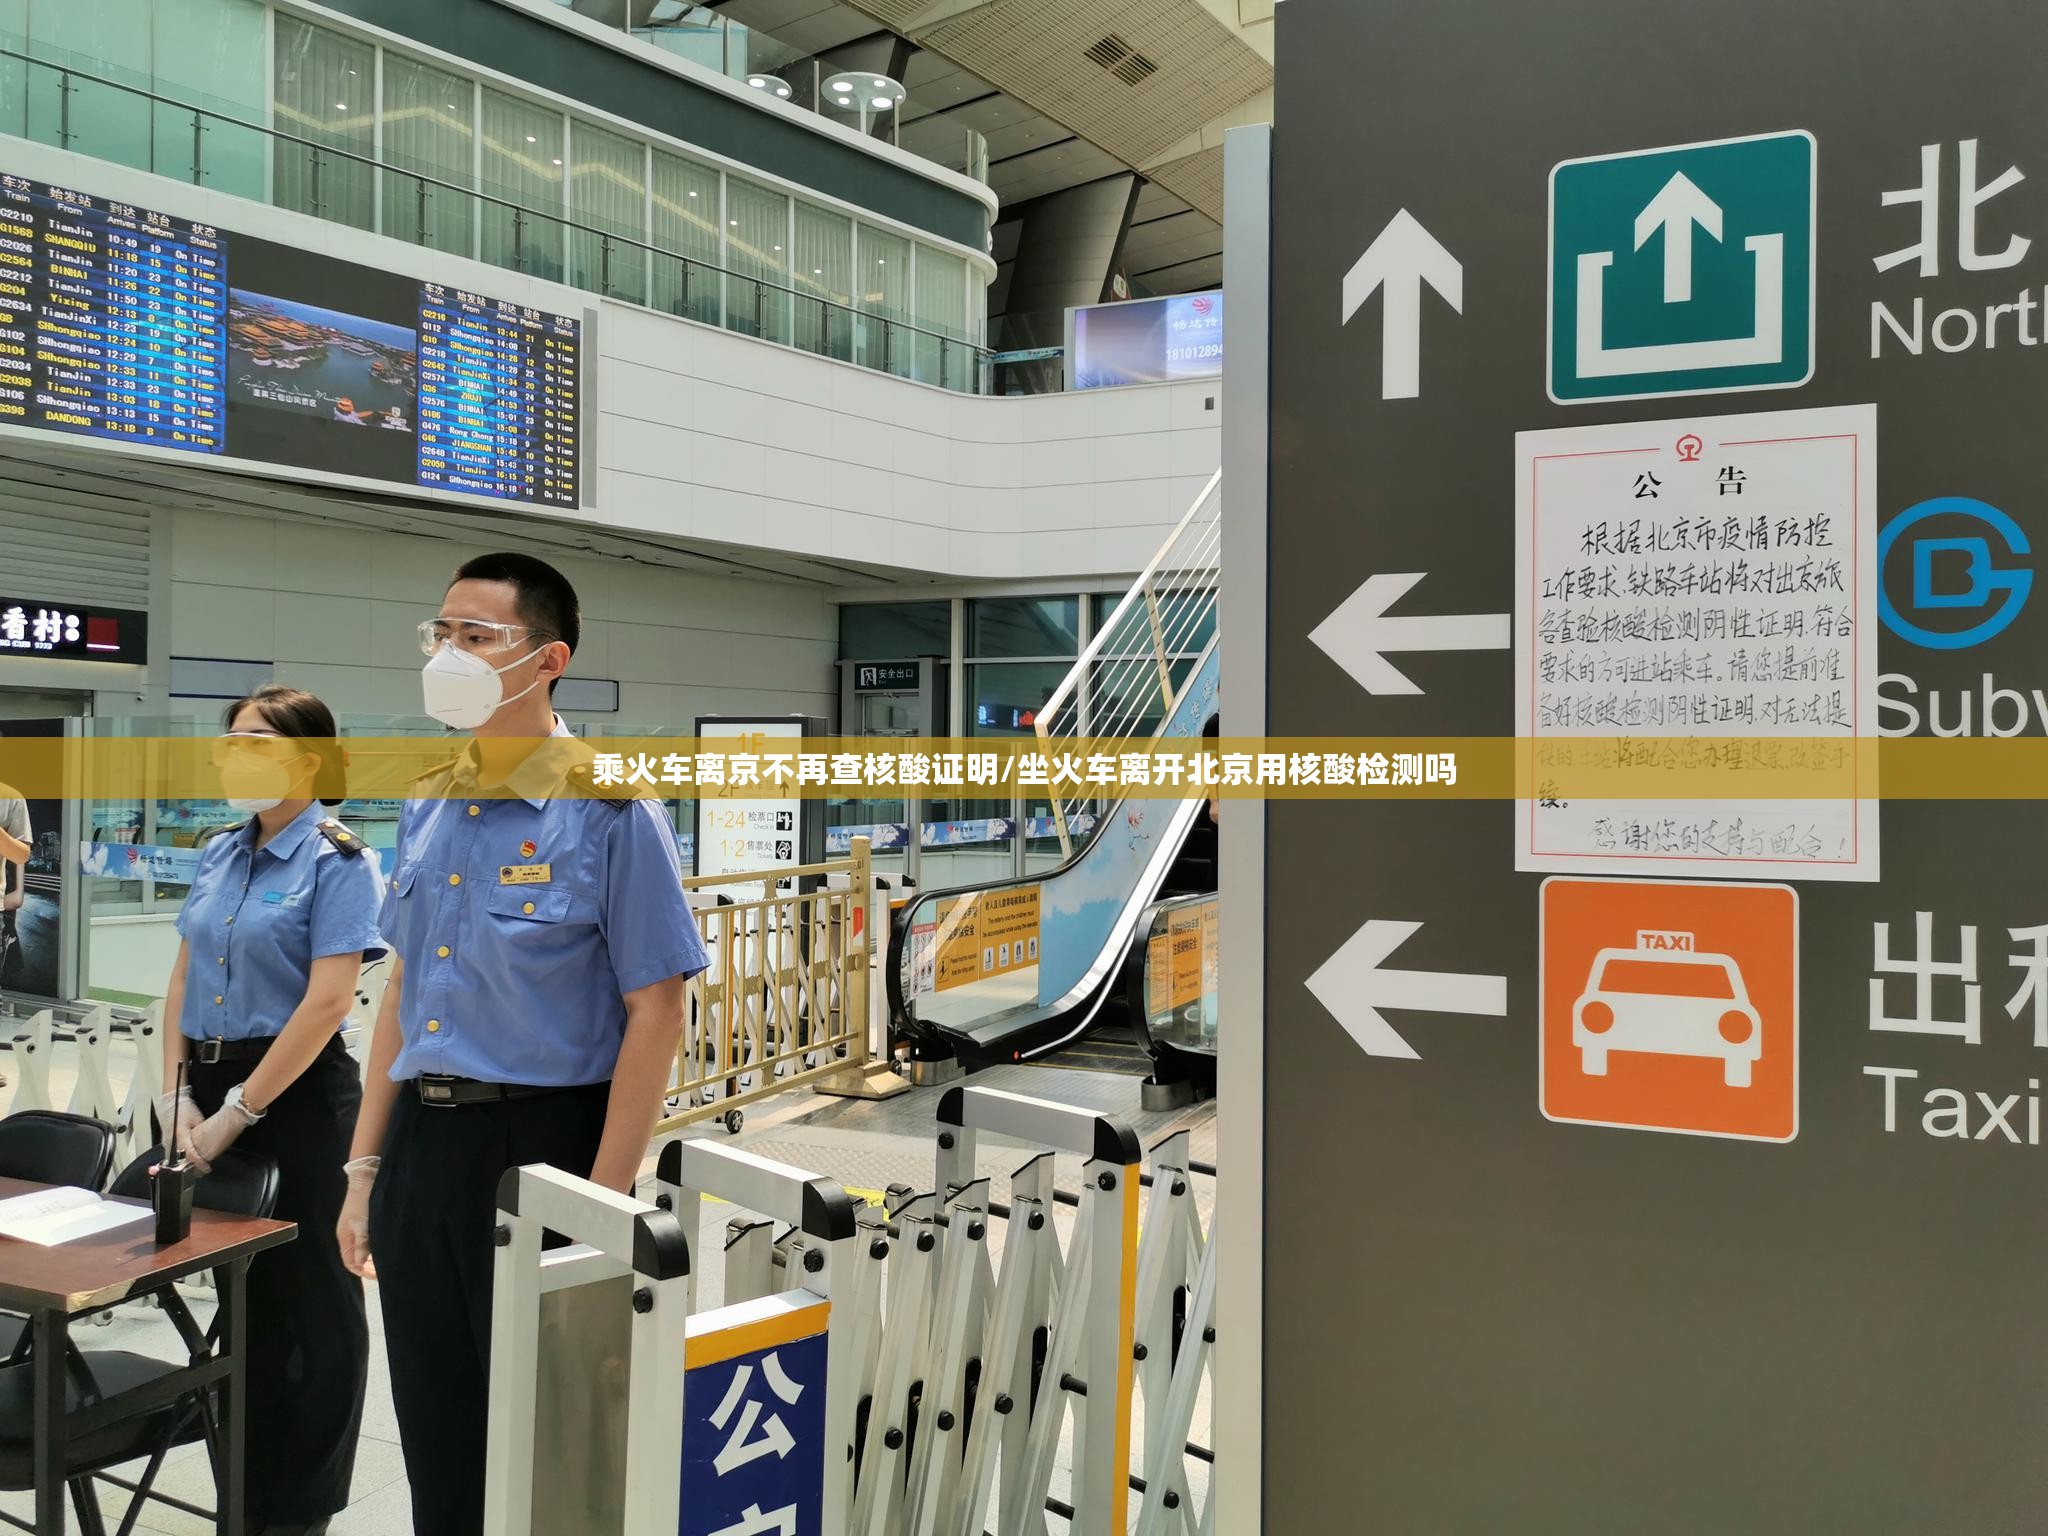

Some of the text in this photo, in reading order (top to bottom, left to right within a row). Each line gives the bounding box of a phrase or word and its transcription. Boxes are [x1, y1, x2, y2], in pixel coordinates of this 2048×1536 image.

[2, 174, 217, 239] 车次 始发站 到达 站台 状态
[4, 190, 31, 203] Train
[57, 203, 83, 216] From
[141, 224, 175, 239] Platform
[190, 236, 218, 250] Status
[1873, 139, 2031, 277] 北
[0, 208, 33, 223] C2210
[109, 234, 137, 248] 10:49
[151, 244, 161, 253] 19
[176, 250, 187, 260] On
[193, 254, 215, 266] Time
[0, 223, 33, 238] G1568
[109, 249, 137, 262] 11:18
[151, 259, 161, 267] 15
[175, 265, 187, 273] On
[193, 268, 215, 280] Time
[0, 239, 32, 253] C2026
[108, 264, 137, 276] 11:20
[149, 273, 160, 282] 23
[175, 279, 187, 288] On
[193, 282, 215, 294] Time
[0, 253, 32, 267] C2564
[108, 278, 136, 290] 11:26
[149, 286, 160, 295] 22
[175, 292, 187, 301] On
[193, 296, 215, 307] Time
[425, 283, 445, 297] 车次
[0, 268, 32, 283] C2212
[108, 292, 137, 305] 11:50
[149, 301, 160, 310] 23
[175, 307, 187, 315] On
[192, 310, 214, 322] Time
[0, 283, 25, 295] G204
[108, 306, 137, 318] 12:13
[148, 314, 155, 322] 8
[175, 320, 186, 329] On
[193, 323, 214, 334] Time
[0, 298, 32, 312] C2634
[108, 320, 137, 333] 12:23
[150, 329, 160, 337] 19
[174, 334, 186, 343] On
[192, 337, 214, 348] Time
[0, 313, 13, 323] G8
[108, 335, 136, 347] 12:24
[150, 343, 160, 351] 10
[174, 348, 186, 356] On
[192, 351, 214, 362] Time
[1871, 285, 2048, 358] Nort
[0, 329, 25, 341] G102
[107, 350, 136, 361] 12:29
[174, 362, 186, 371] On
[192, 365, 214, 376] Time
[0, 343, 25, 356] G104
[107, 364, 135, 376] 12:33
[149, 372, 159, 380] 11
[174, 376, 186, 385] On
[191, 379, 214, 390] Time
[0, 358, 31, 371] C2034
[107, 378, 135, 390] 12:33
[147, 385, 159, 393] 23
[174, 390, 185, 398] On
[192, 392, 214, 403] Time
[0, 373, 32, 386] C2038
[107, 393, 135, 404] 13:03
[173, 404, 185, 413] On
[191, 407, 214, 417] Time
[0, 388, 25, 400] G106
[107, 406, 135, 418] 13:13
[149, 413, 159, 422] 15
[173, 417, 185, 426] On
[191, 420, 213, 431] Time
[0, 404, 25, 415] G398
[106, 421, 135, 432] 13:18
[173, 432, 185, 440] On
[191, 434, 213, 445] Time
[557, 480, 572, 489] Time
[557, 492, 572, 501] Time
[1580, 512, 1833, 556] 根据北京市疫情防控
[878, 668, 913, 679] 安全出口
[1641, 934, 1692, 952] TAXI
[1863, 1066, 2039, 1145] Taxi
